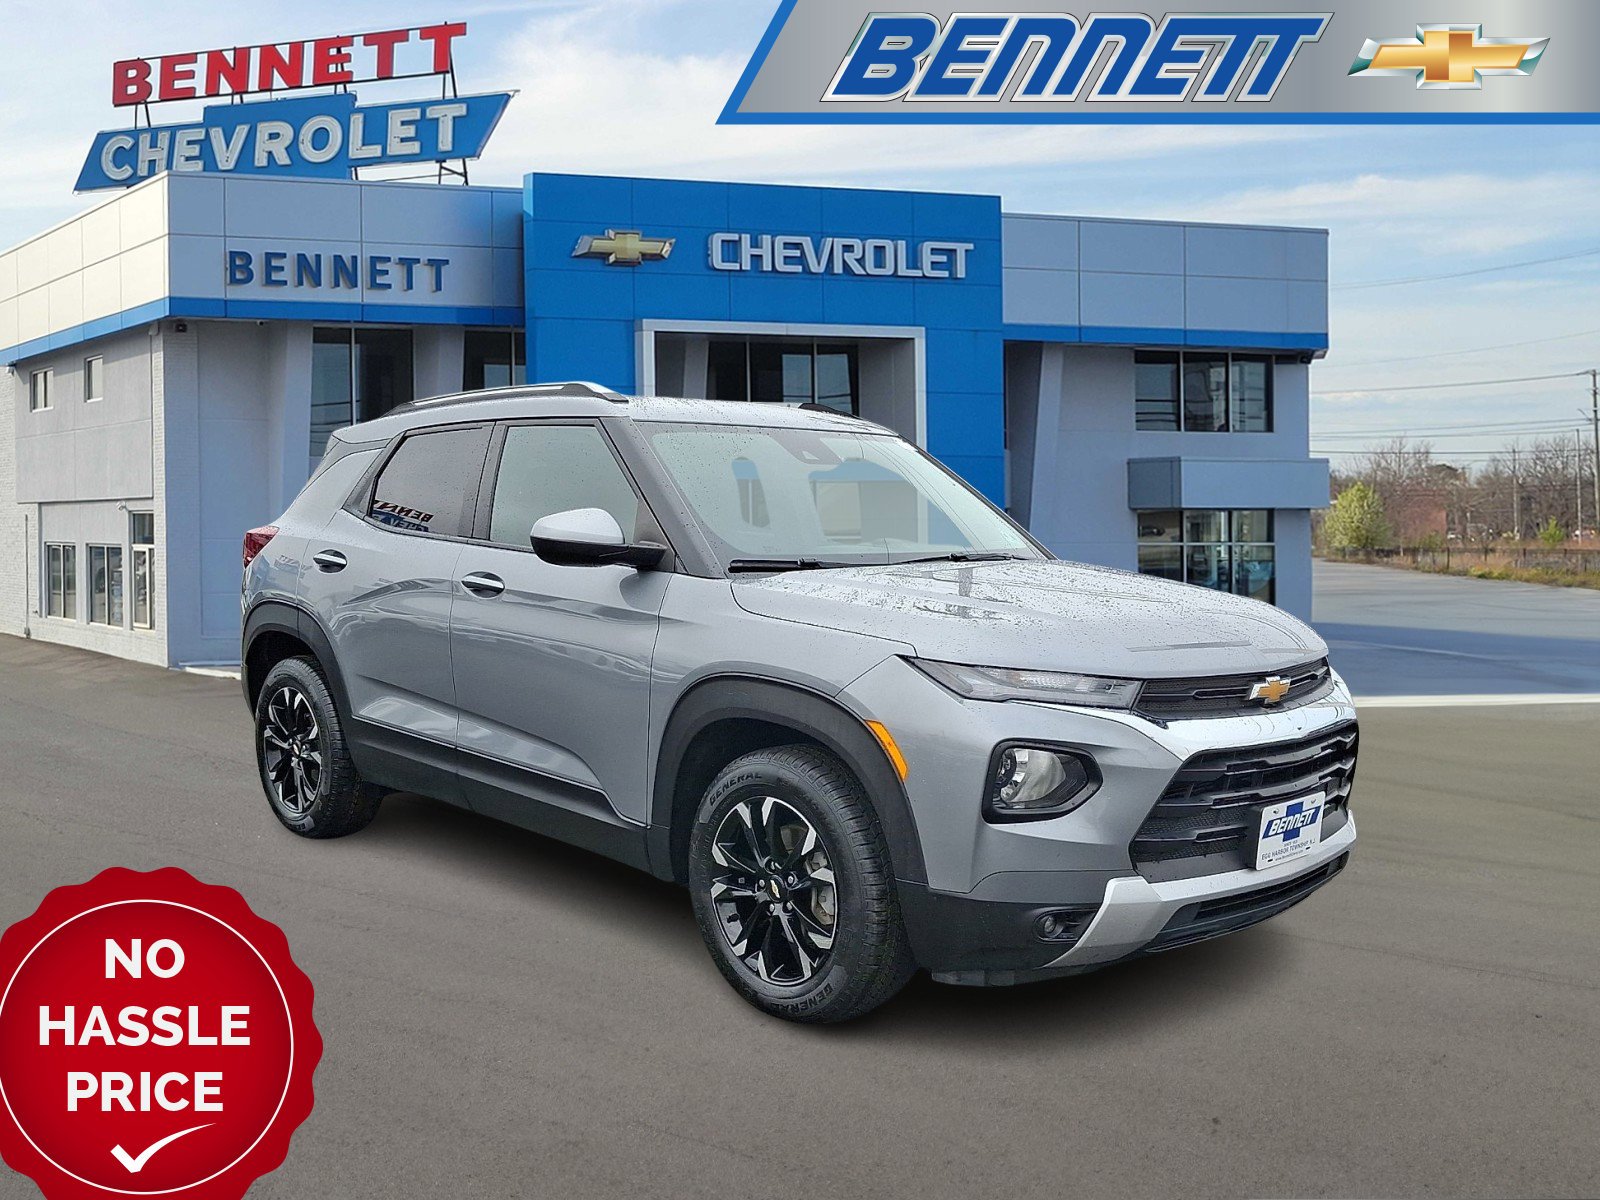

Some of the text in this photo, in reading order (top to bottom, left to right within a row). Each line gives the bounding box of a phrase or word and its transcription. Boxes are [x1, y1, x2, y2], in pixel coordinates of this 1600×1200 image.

[113, 22, 467, 107] BENNETT
[101, 105, 468, 180] CHEVROLET
[226, 249, 450, 293] BENNETT
[708, 232, 974, 278] CHEVROLET
[709, 773, 763, 806] GENERAL
[1269, 809, 1315, 835] BENNETT
